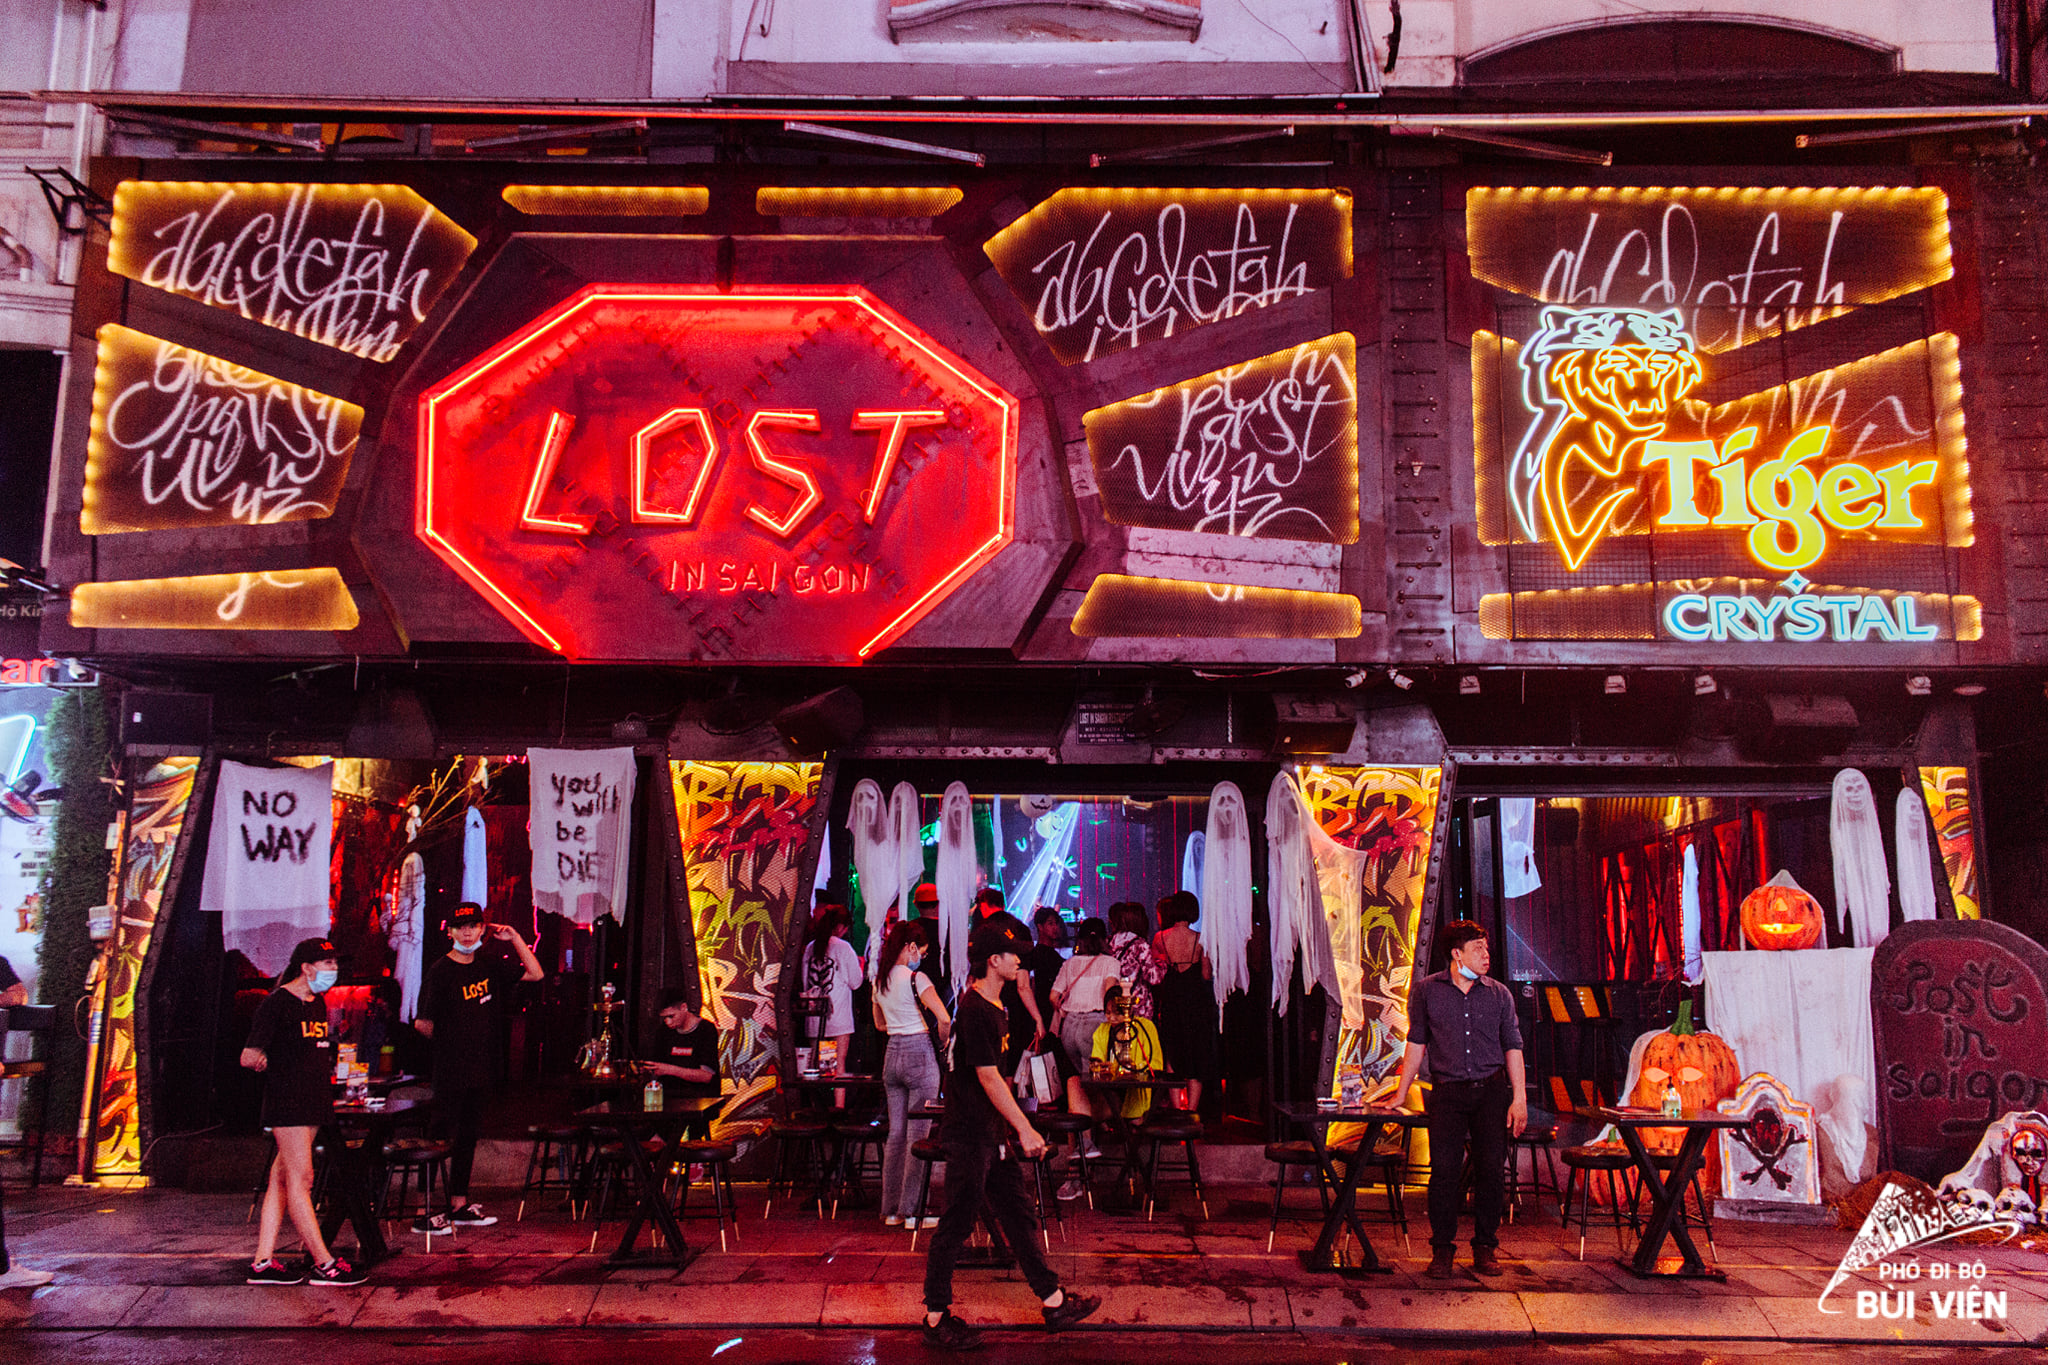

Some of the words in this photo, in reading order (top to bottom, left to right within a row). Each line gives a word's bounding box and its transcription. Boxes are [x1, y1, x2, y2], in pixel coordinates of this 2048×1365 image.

[519, 406, 949, 538] LOST
[1640, 426, 1938, 570] Tiger
[669, 559, 706, 592] IN
[718, 561, 870, 594] SAIGON
[1663, 594, 1938, 642] CRYSTAL
[243, 790, 297, 817] NO
[551, 771, 602, 808] you
[241, 821, 317, 864] WAY
[556, 820, 586, 842] be
[455, 907, 474, 917] LOST
[462, 978, 489, 1001] LOST
[301, 1021, 328, 1038] LOST
[1943, 1016, 1997, 1058] in
